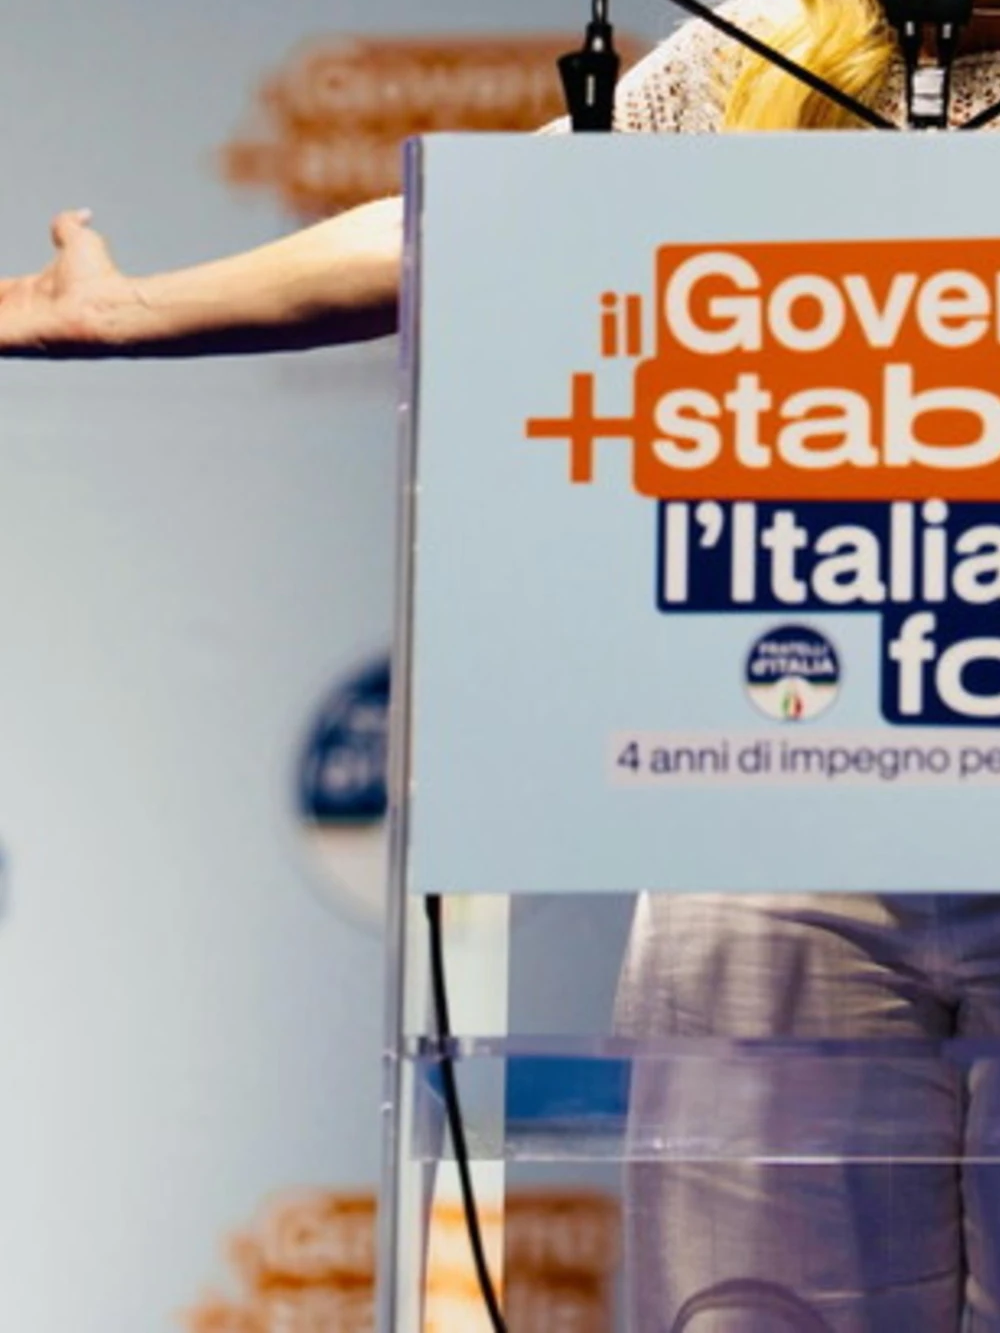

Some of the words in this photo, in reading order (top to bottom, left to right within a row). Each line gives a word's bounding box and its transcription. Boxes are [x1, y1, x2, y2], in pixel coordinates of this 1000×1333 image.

[600, 292, 642, 357] il
[617, 741, 640, 772] 4
[650, 739, 730, 774] anni
[738, 741, 772, 774] di
[780, 740, 950, 780] impegno
